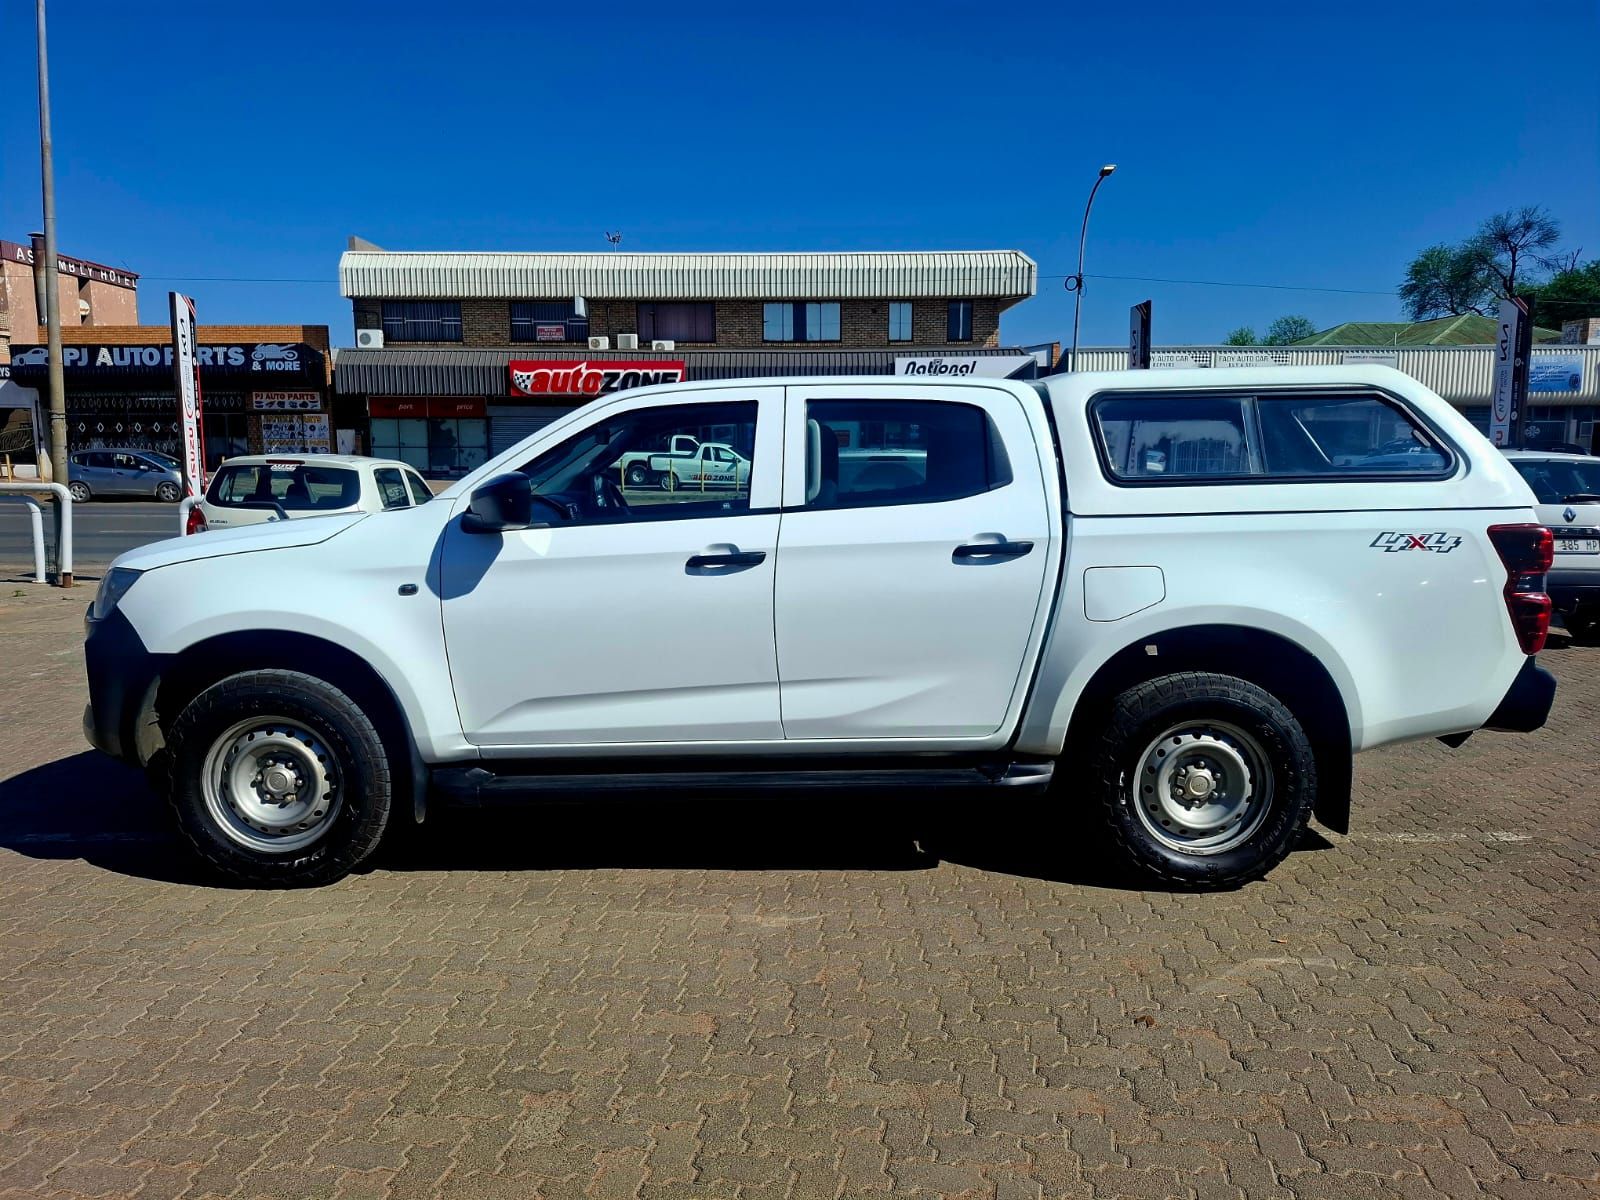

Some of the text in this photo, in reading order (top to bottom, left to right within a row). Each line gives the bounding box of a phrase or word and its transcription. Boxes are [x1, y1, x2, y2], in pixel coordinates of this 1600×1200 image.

[16, 247, 138, 288] ASMBLY HOTEL
[180, 318, 188, 356] KIA
[1500, 324, 1509, 362] KIA
[63, 346, 245, 367] PJ AUTO PRTS
[251, 361, 301, 371] & MORE
[904, 359, 977, 375] National
[188, 427, 197, 478] ISUZU
